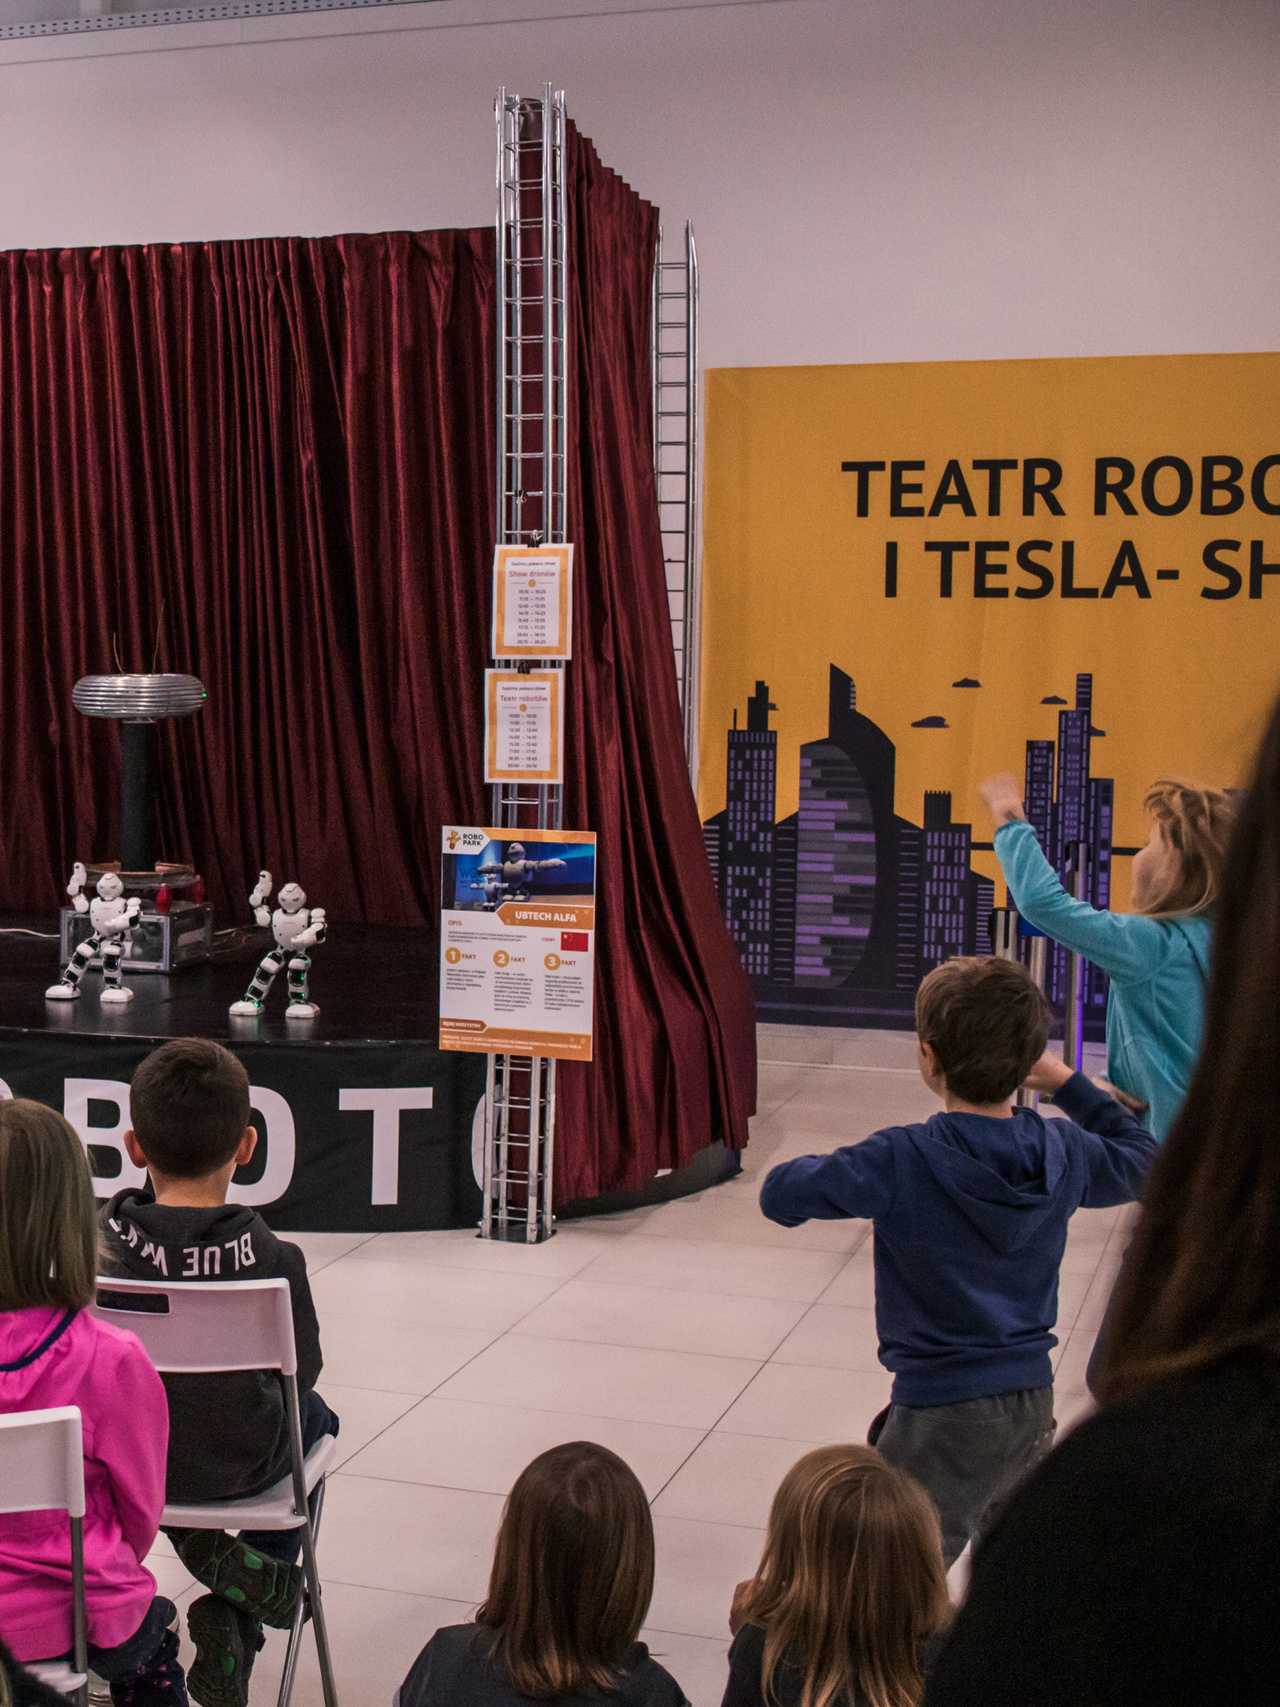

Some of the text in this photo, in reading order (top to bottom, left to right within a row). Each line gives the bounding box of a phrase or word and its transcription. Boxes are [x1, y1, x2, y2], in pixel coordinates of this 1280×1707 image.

[841, 458, 1067, 518] TEATR
[885, 541, 898, 598] I
[924, 540, 1179, 600] TESLA-
[462, 833, 484, 841] ROBO
[515, 911, 577, 922] UBTECH ALFA
[182, 1232, 256, 1277] BLUE
